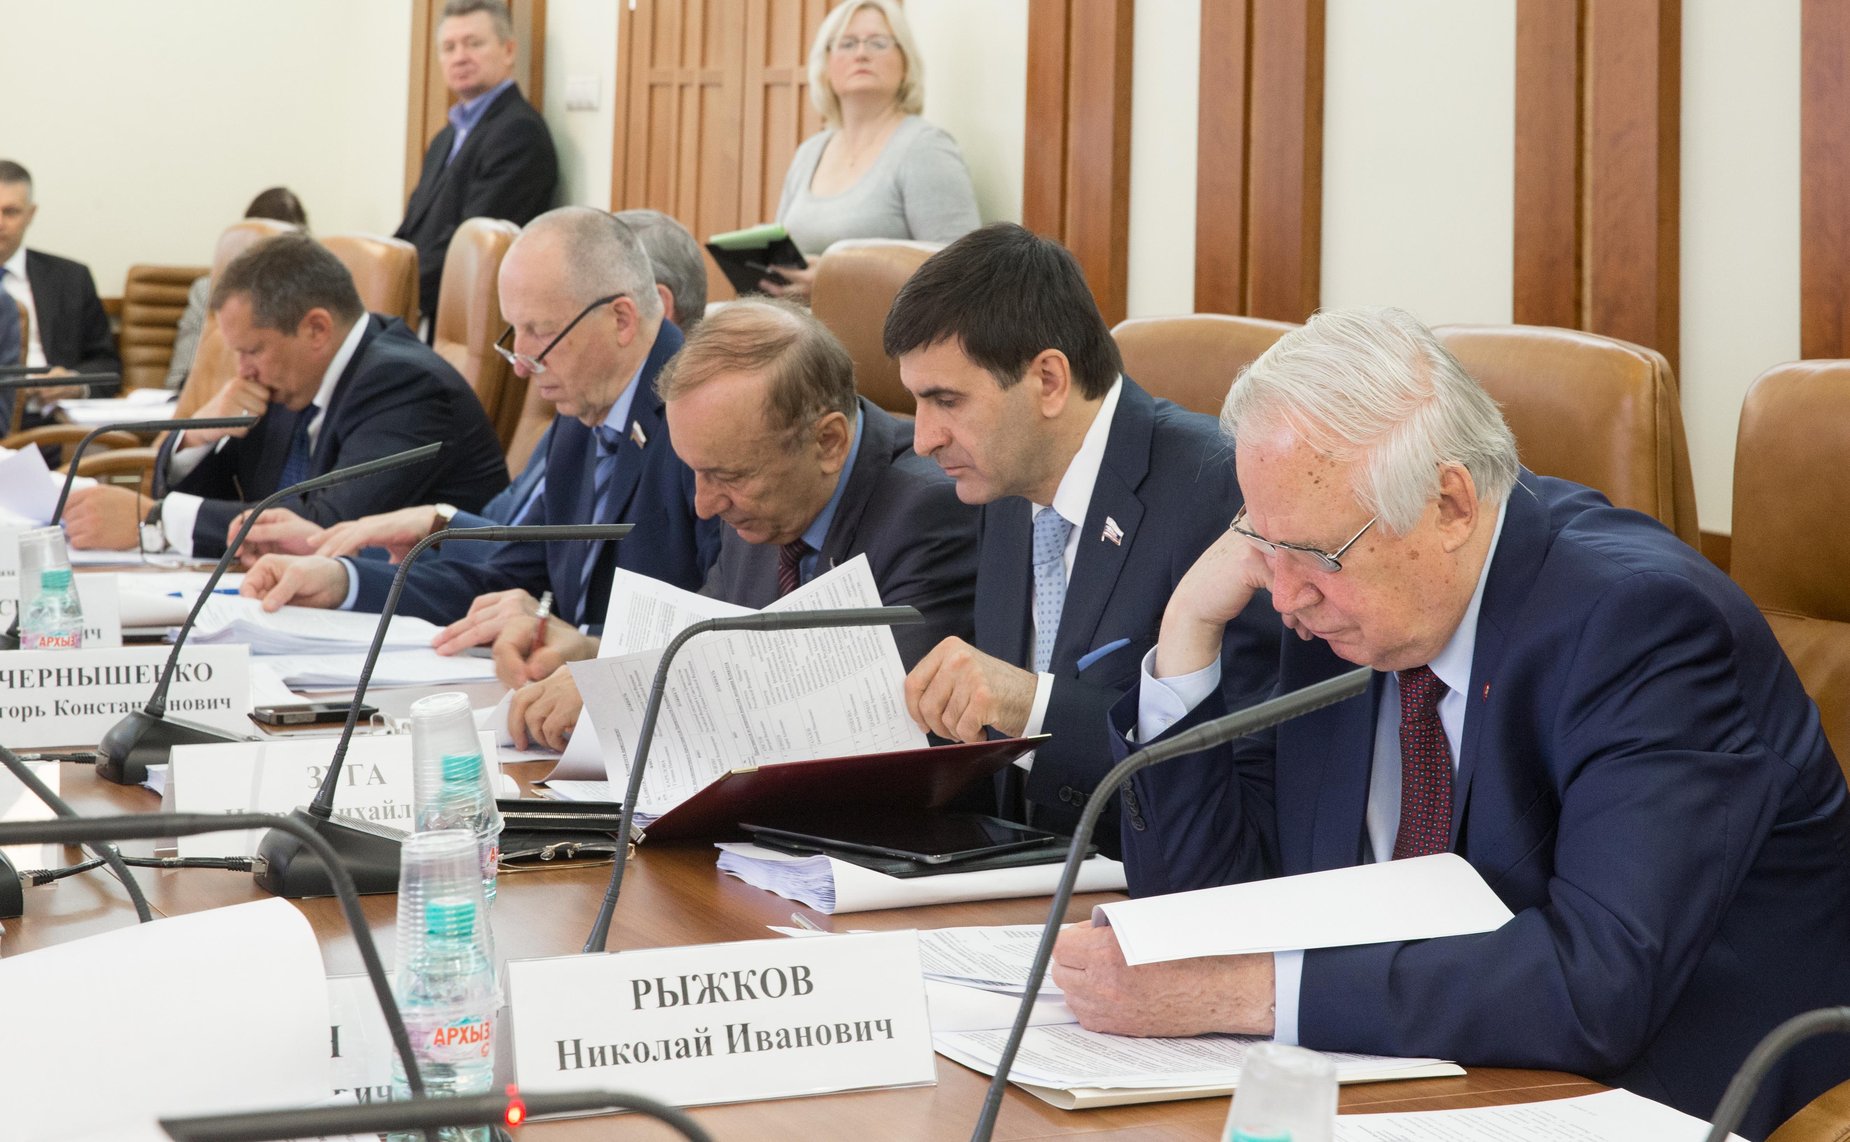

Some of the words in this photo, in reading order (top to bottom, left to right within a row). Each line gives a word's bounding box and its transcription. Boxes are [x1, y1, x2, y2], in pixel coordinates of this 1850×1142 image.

[39, 635, 76, 648] АРХЫЗ
[54, 696, 231, 717] Констаннович
[306, 763, 388, 790] ЗГА
[631, 964, 815, 1011] РЫЖКОВ
[433, 1021, 490, 1046] АРХЫЗ
[556, 1026, 716, 1072] Николай
[723, 1017, 895, 1055] Иванович
